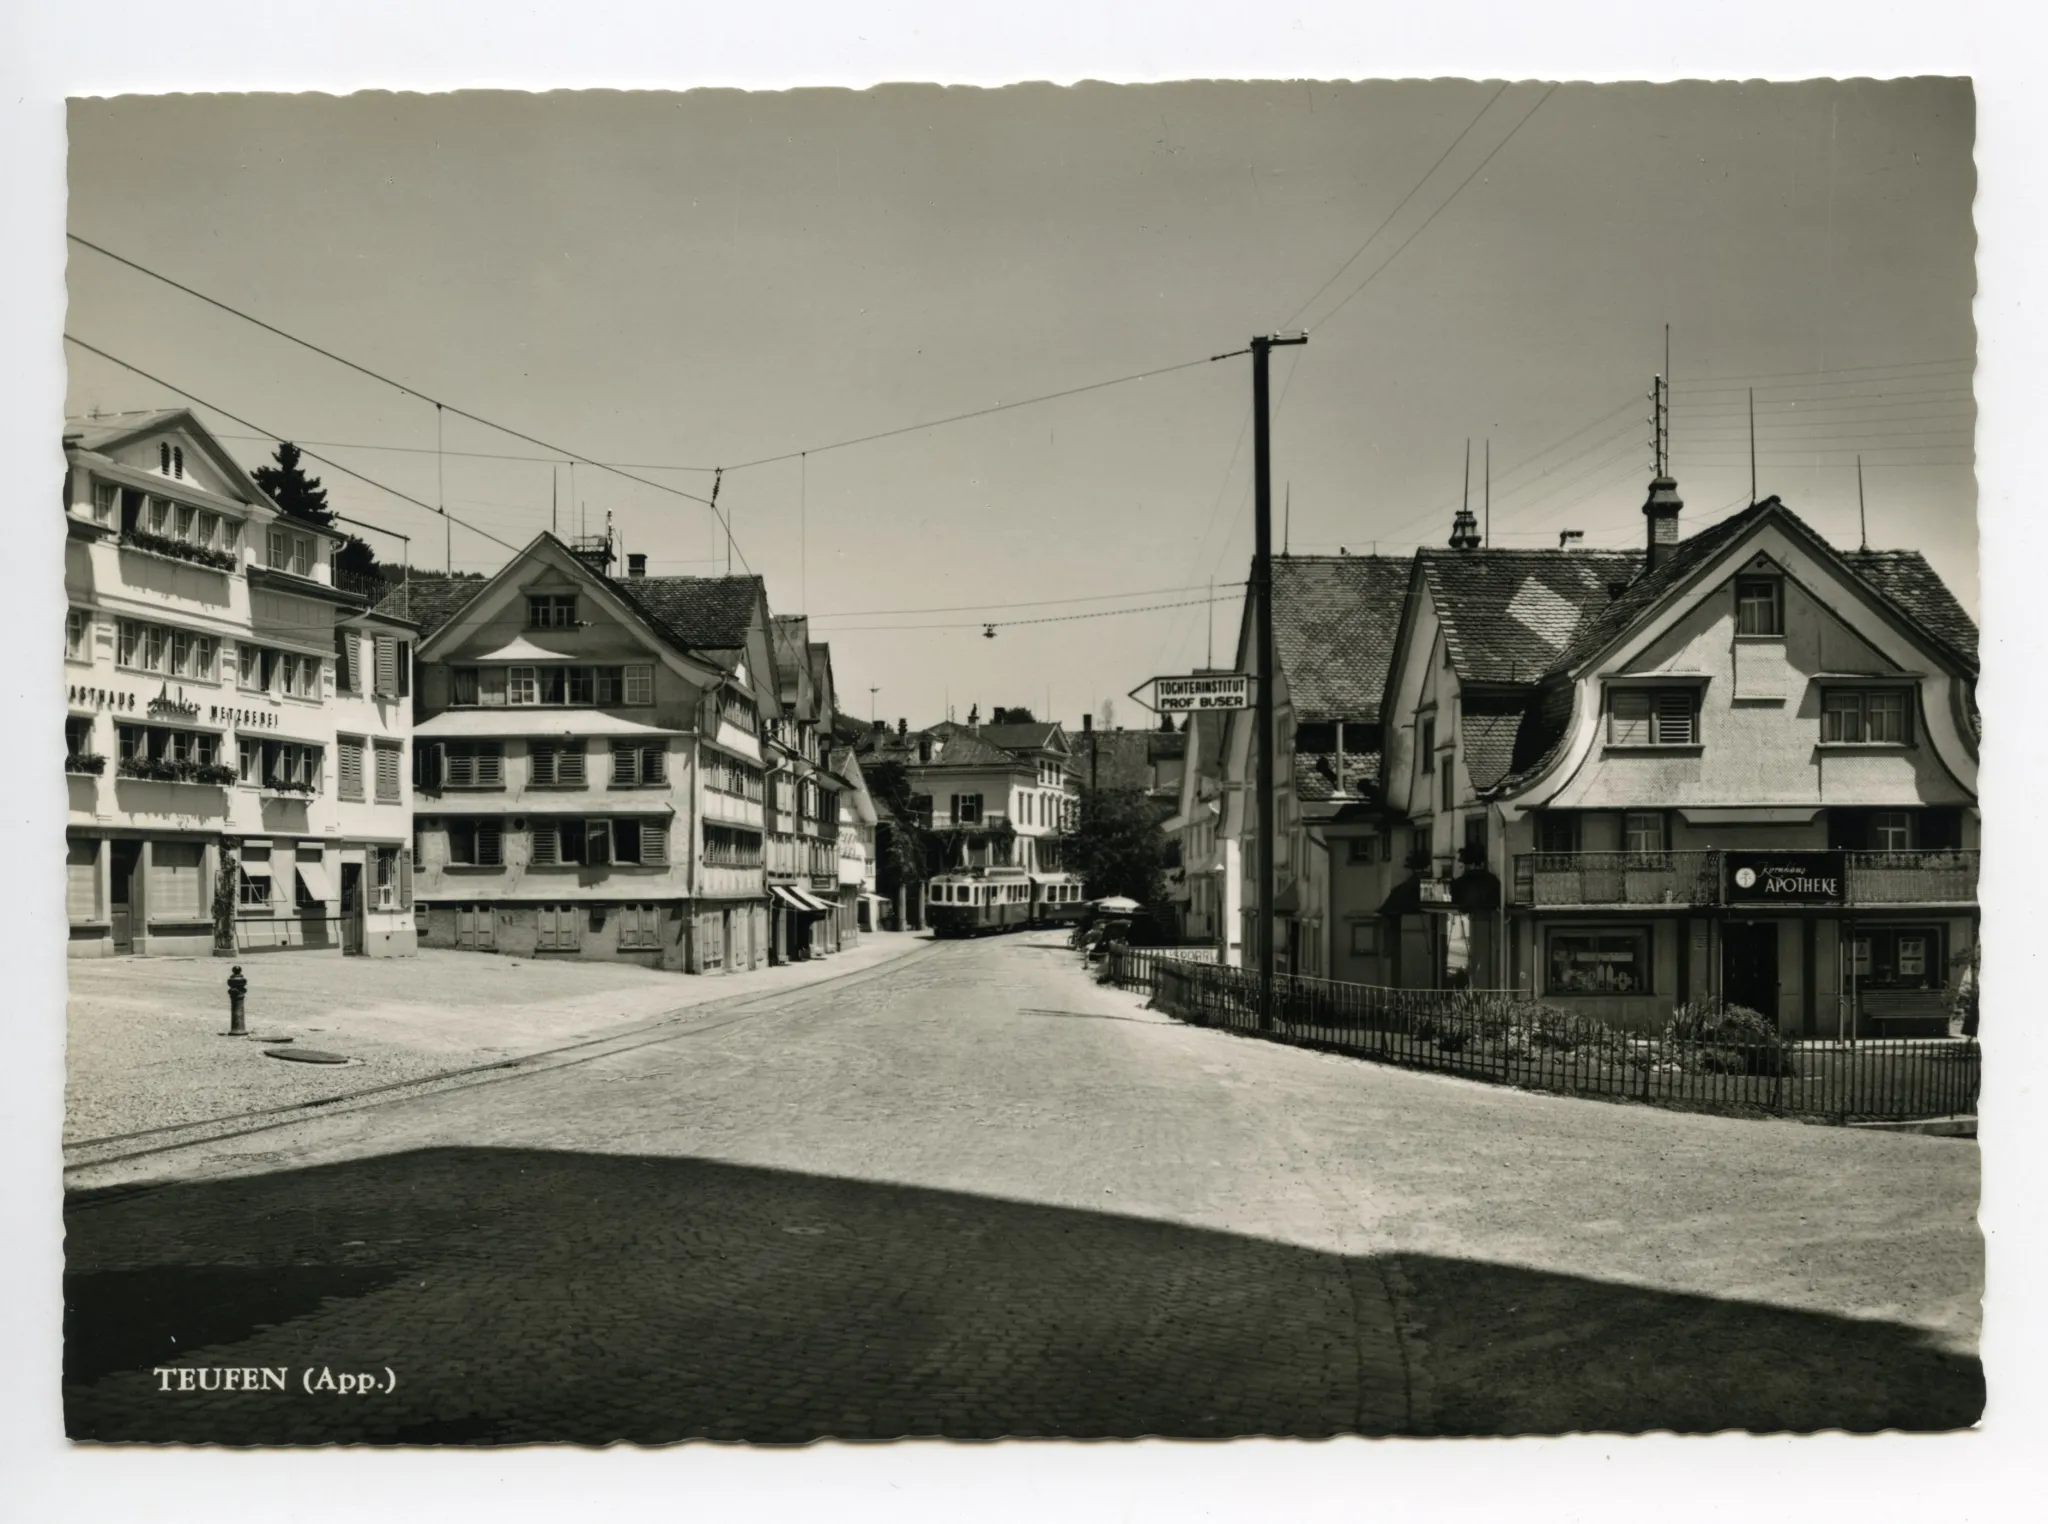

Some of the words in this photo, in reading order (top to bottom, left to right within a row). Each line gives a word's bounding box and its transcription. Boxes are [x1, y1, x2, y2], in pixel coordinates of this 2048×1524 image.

[1160, 680, 1245, 695] TOCHTERINSTITUT
[68, 684, 135, 707] ASTHAUS
[210, 705, 278, 727] METZGEREI
[1199, 696, 1244, 708] BUSER
[1764, 877, 1840, 896] APOTHEKE
